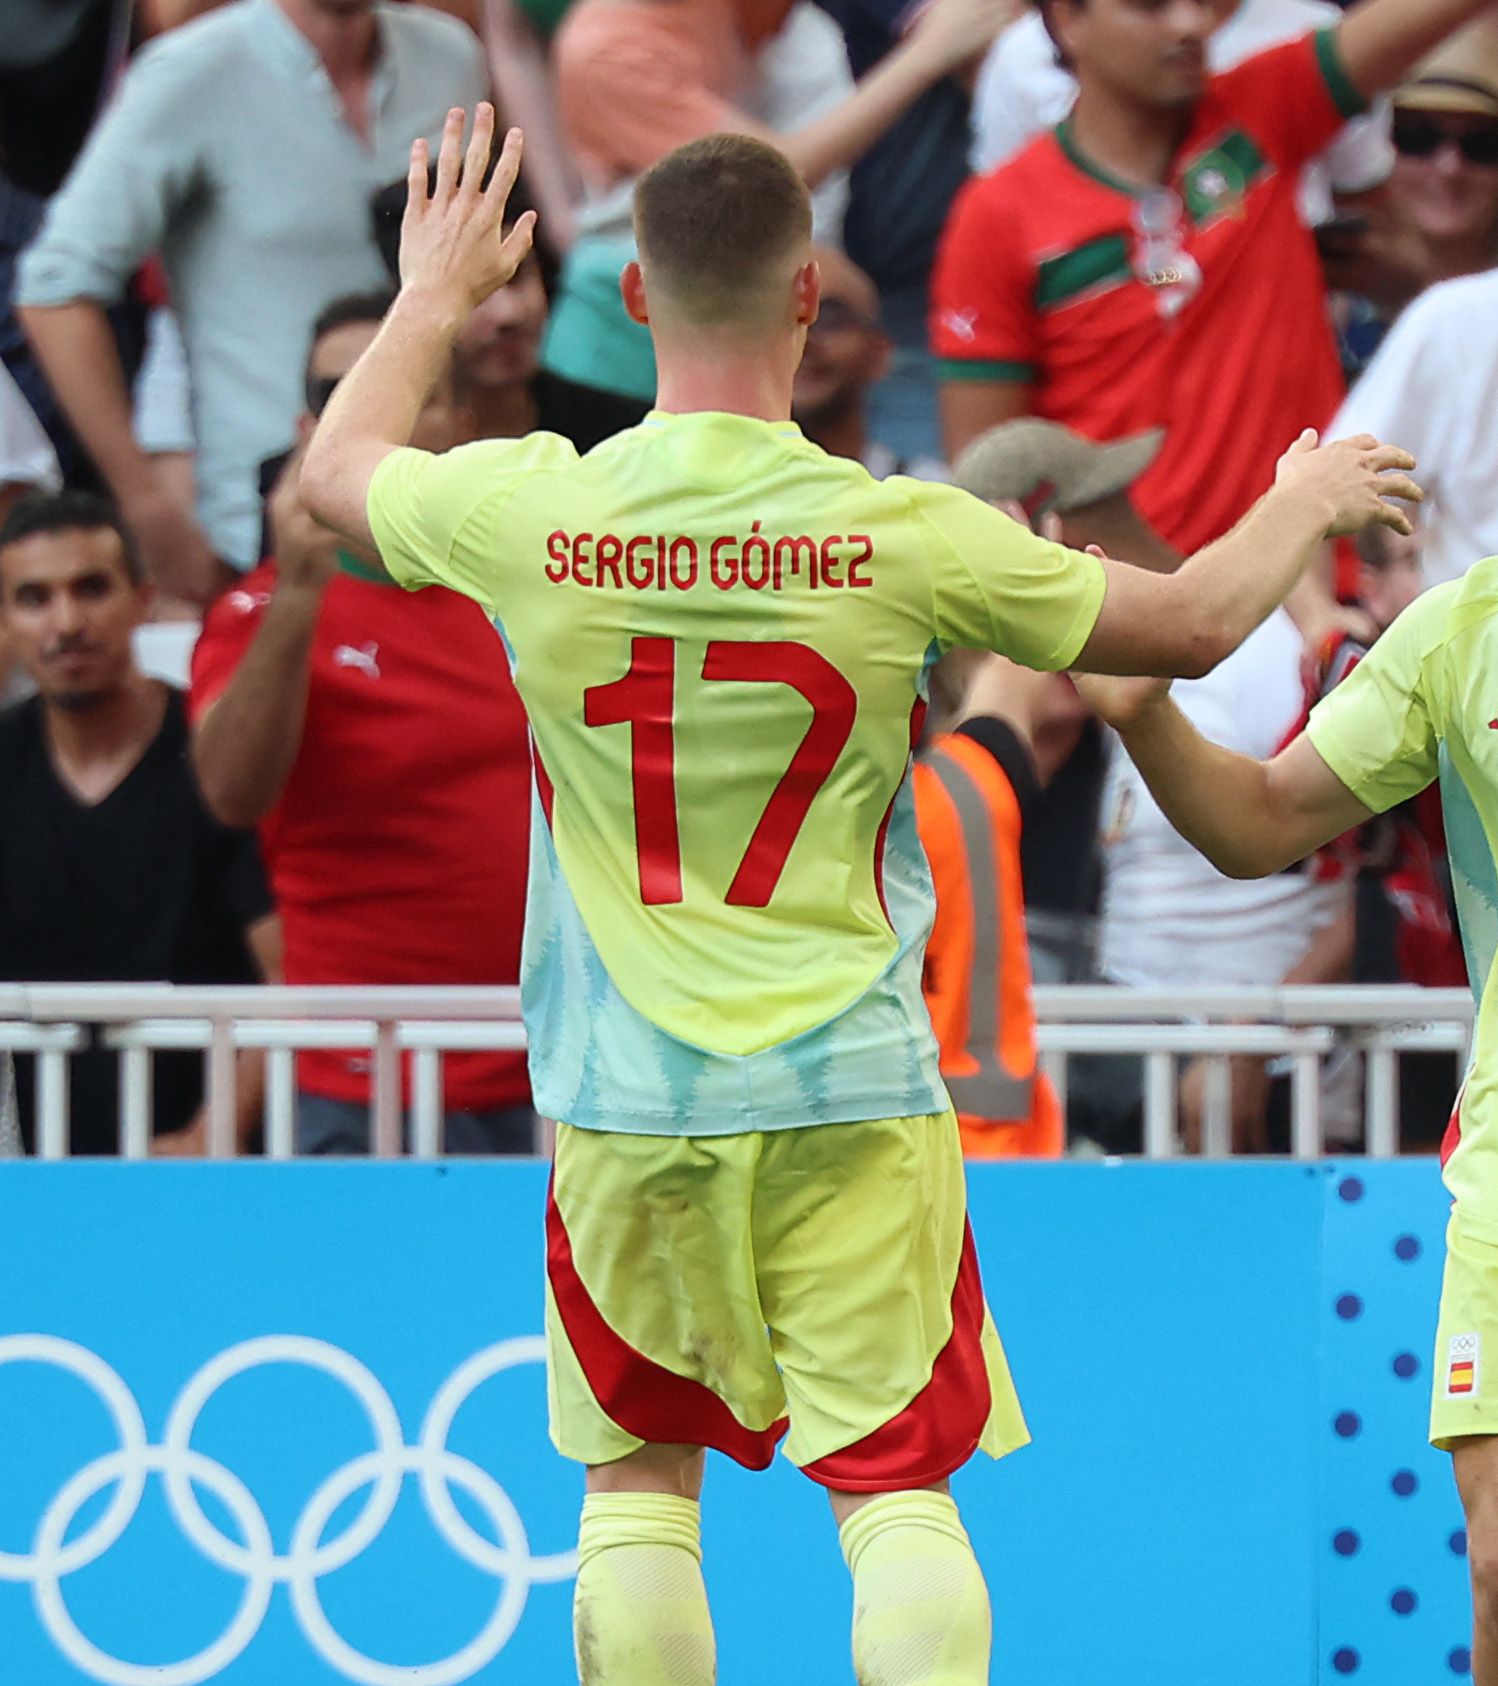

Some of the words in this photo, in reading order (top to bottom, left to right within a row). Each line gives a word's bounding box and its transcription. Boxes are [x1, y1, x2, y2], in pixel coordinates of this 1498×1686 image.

[545, 529, 698, 591] SERGIO
[710, 520, 874, 591] GÓMEZ
[584, 636, 858, 907] 17
